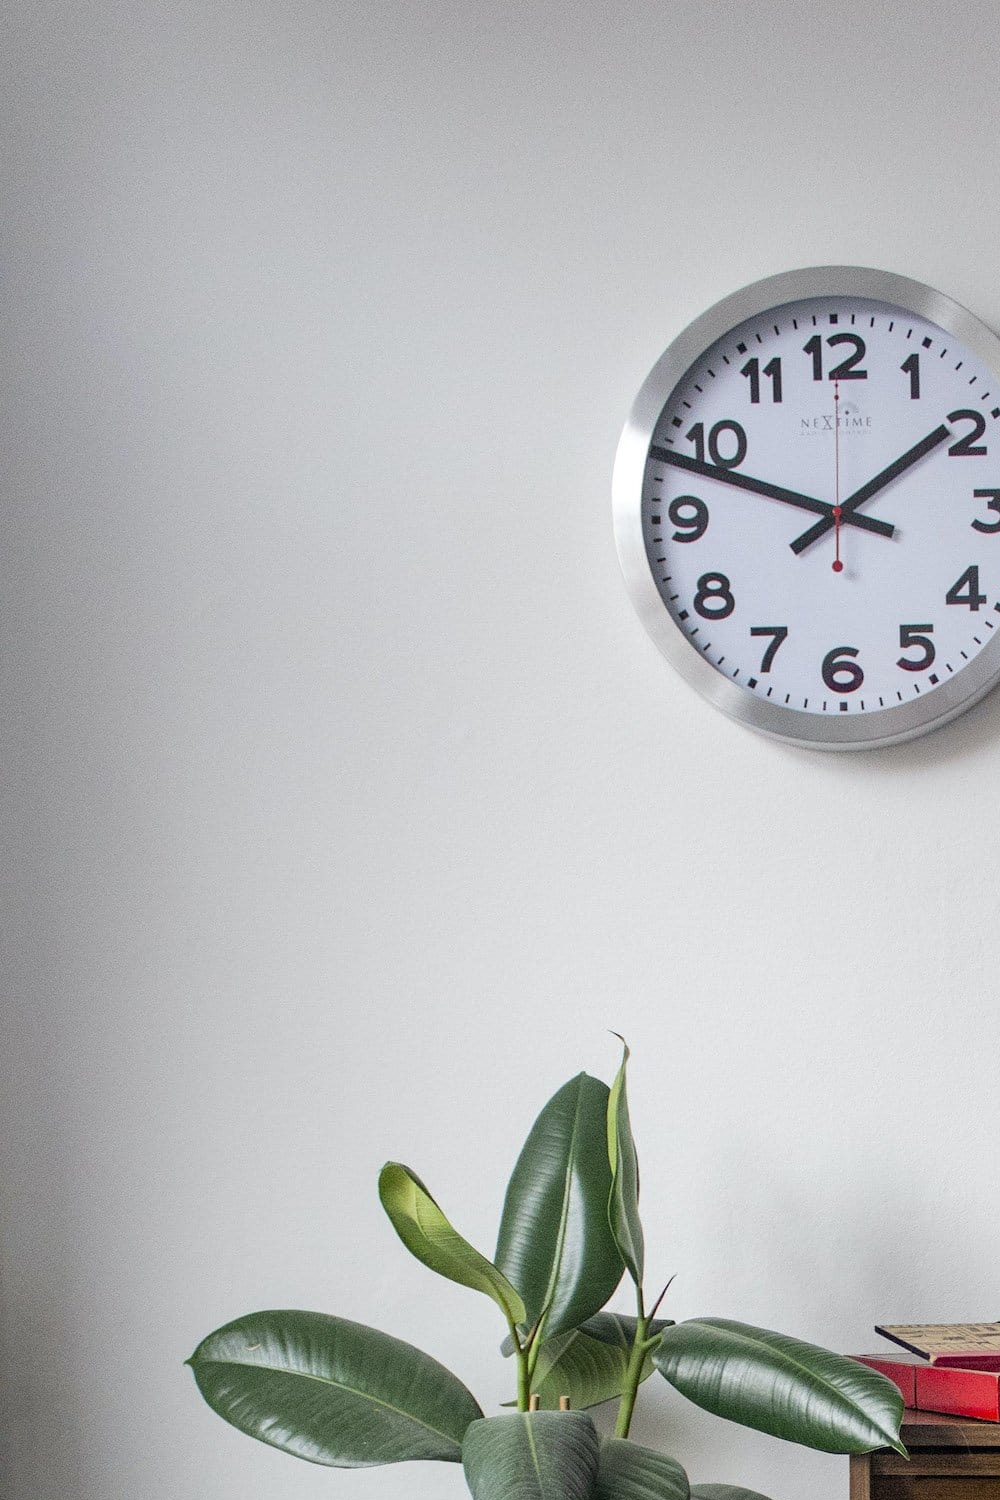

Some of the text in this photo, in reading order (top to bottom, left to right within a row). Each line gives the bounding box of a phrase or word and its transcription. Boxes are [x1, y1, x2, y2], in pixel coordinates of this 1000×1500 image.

[740, 357, 783, 403] 11
[802, 333, 868, 381] 12
[900, 353, 921, 400] 1
[685, 419, 748, 469] 10
[946, 408, 988, 457] 2
[668, 495, 709, 543] 9
[693, 572, 736, 621] 8
[945, 565, 988, 612] 4
[750, 626, 788, 673] 7
[821, 646, 865, 693] 6
[896, 623, 937, 673] 5
